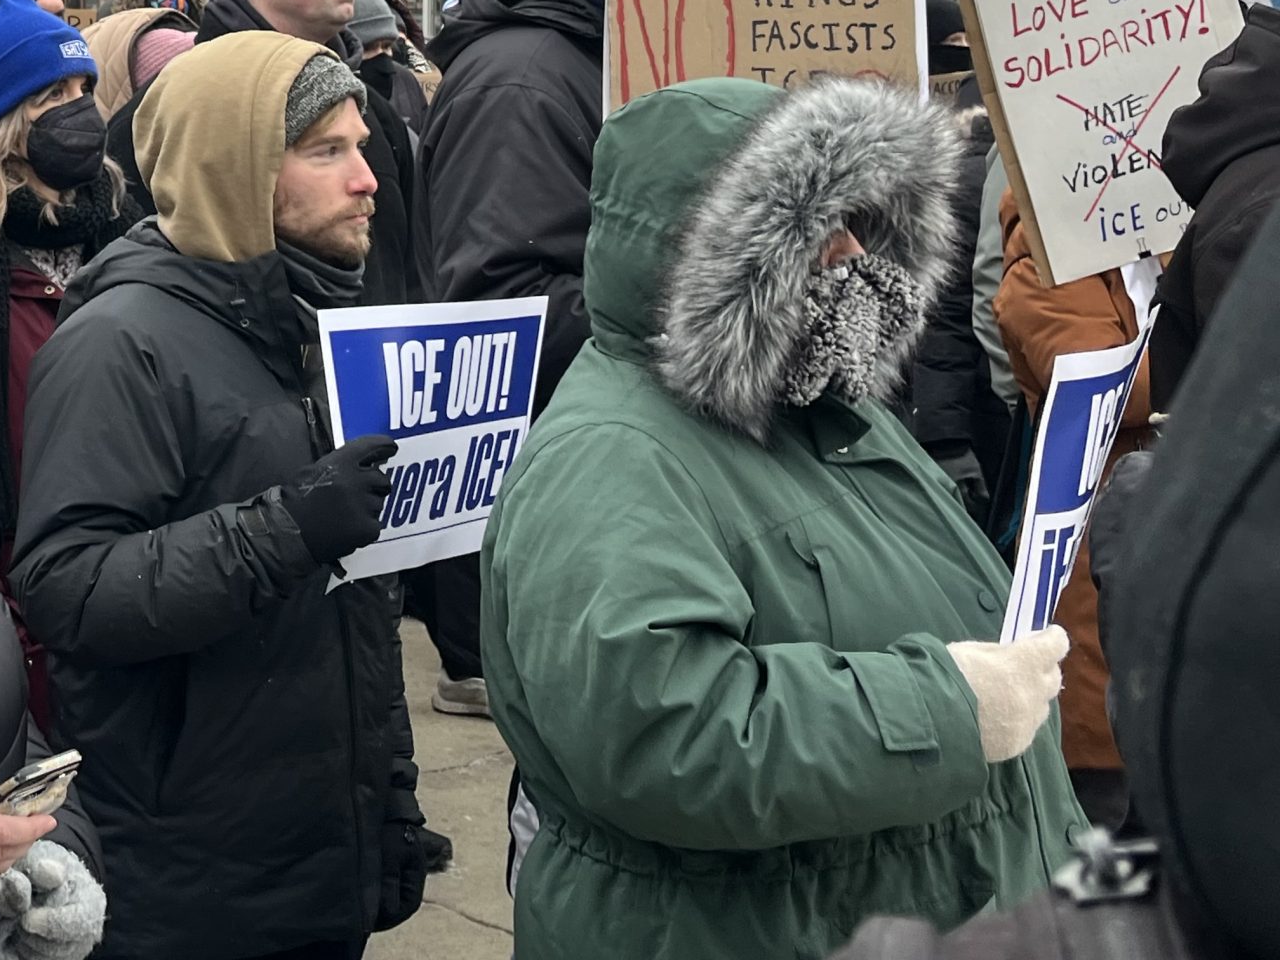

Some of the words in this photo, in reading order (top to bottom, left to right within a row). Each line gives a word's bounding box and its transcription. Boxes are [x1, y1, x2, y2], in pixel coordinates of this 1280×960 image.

[752, 20, 895, 53] FASCISTS
[1084, 94, 1149, 131] HATE
[383, 339, 445, 430] ICE
[446, 331, 518, 420] OUT!
[378, 454, 456, 530] uera
